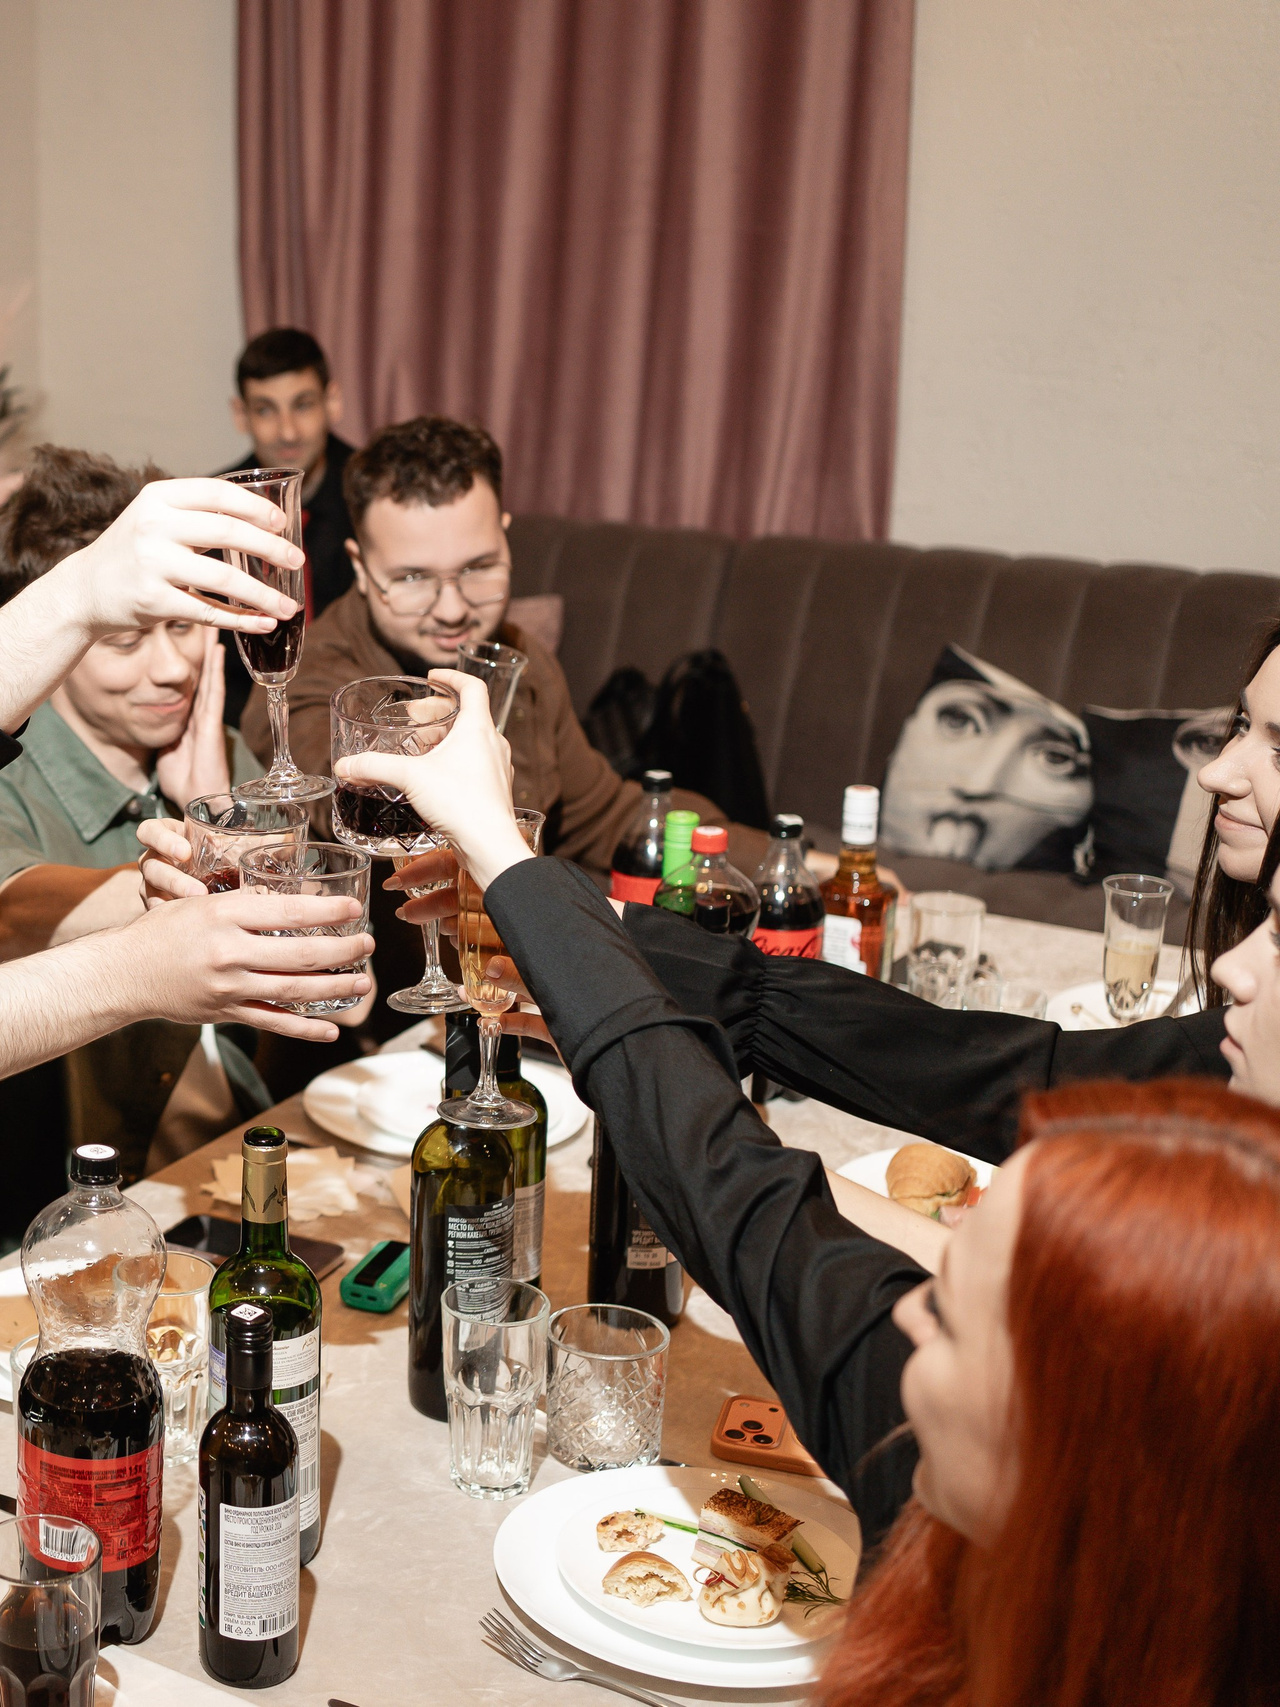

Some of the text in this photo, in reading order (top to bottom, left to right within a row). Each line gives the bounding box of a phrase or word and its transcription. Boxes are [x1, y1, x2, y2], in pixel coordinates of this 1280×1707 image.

[448, 1223, 467, 1231] МЕСТО
[447, 1230, 466, 1239] РЕГИОН
[265, 1563, 278, 1572] ООО
[224, 1587, 247, 1598] ВРЕДИТ
[247, 1590, 273, 1599] ВАШЕМУ
